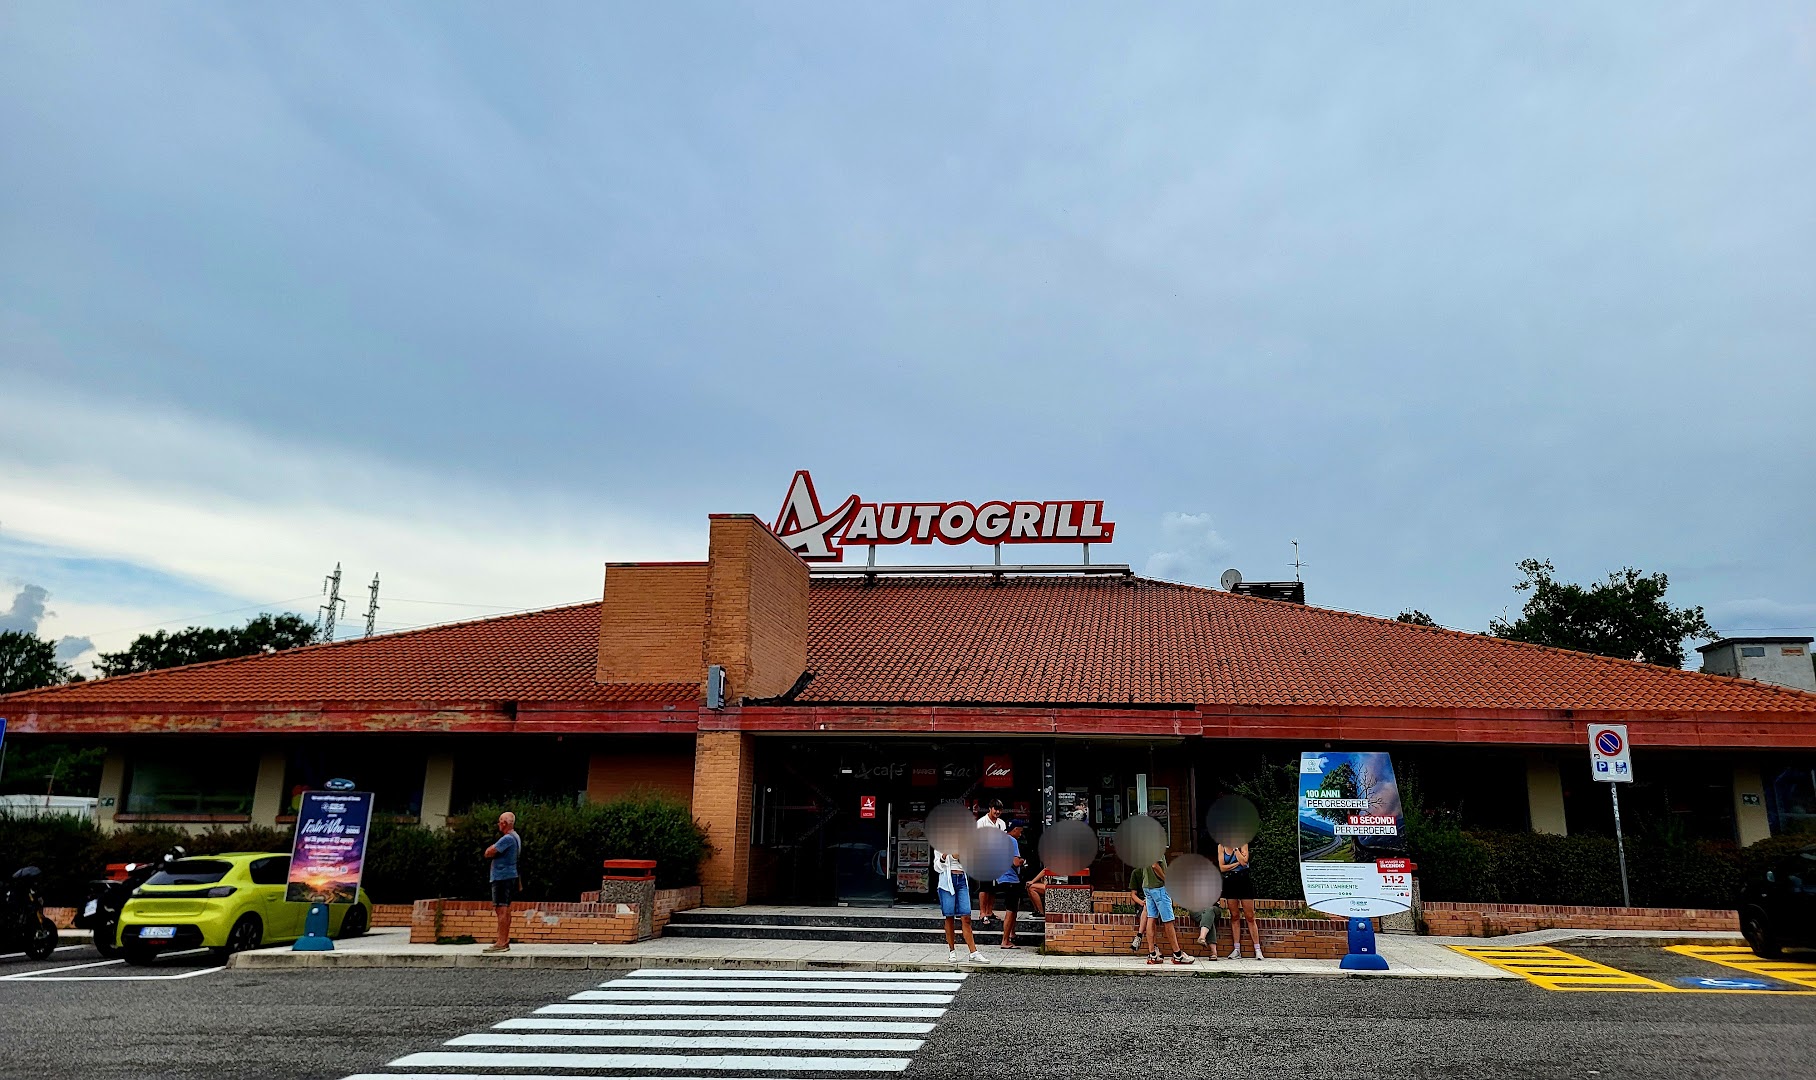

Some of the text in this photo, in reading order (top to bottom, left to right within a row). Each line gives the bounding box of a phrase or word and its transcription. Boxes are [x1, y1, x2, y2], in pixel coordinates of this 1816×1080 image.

[846, 503, 1102, 538] AUTOGRILL
[873, 763, 906, 780] café
[985, 762, 1011, 777] Ciao
[1306, 789, 1341, 798] 100 ANNI
[1307, 799, 1367, 808] PER CRESCERE
[1350, 816, 1395, 825] 10 SECONDI
[1335, 826, 1396, 835] PER PERDERLO
[1383, 875, 1405, 884] 1-1-2
